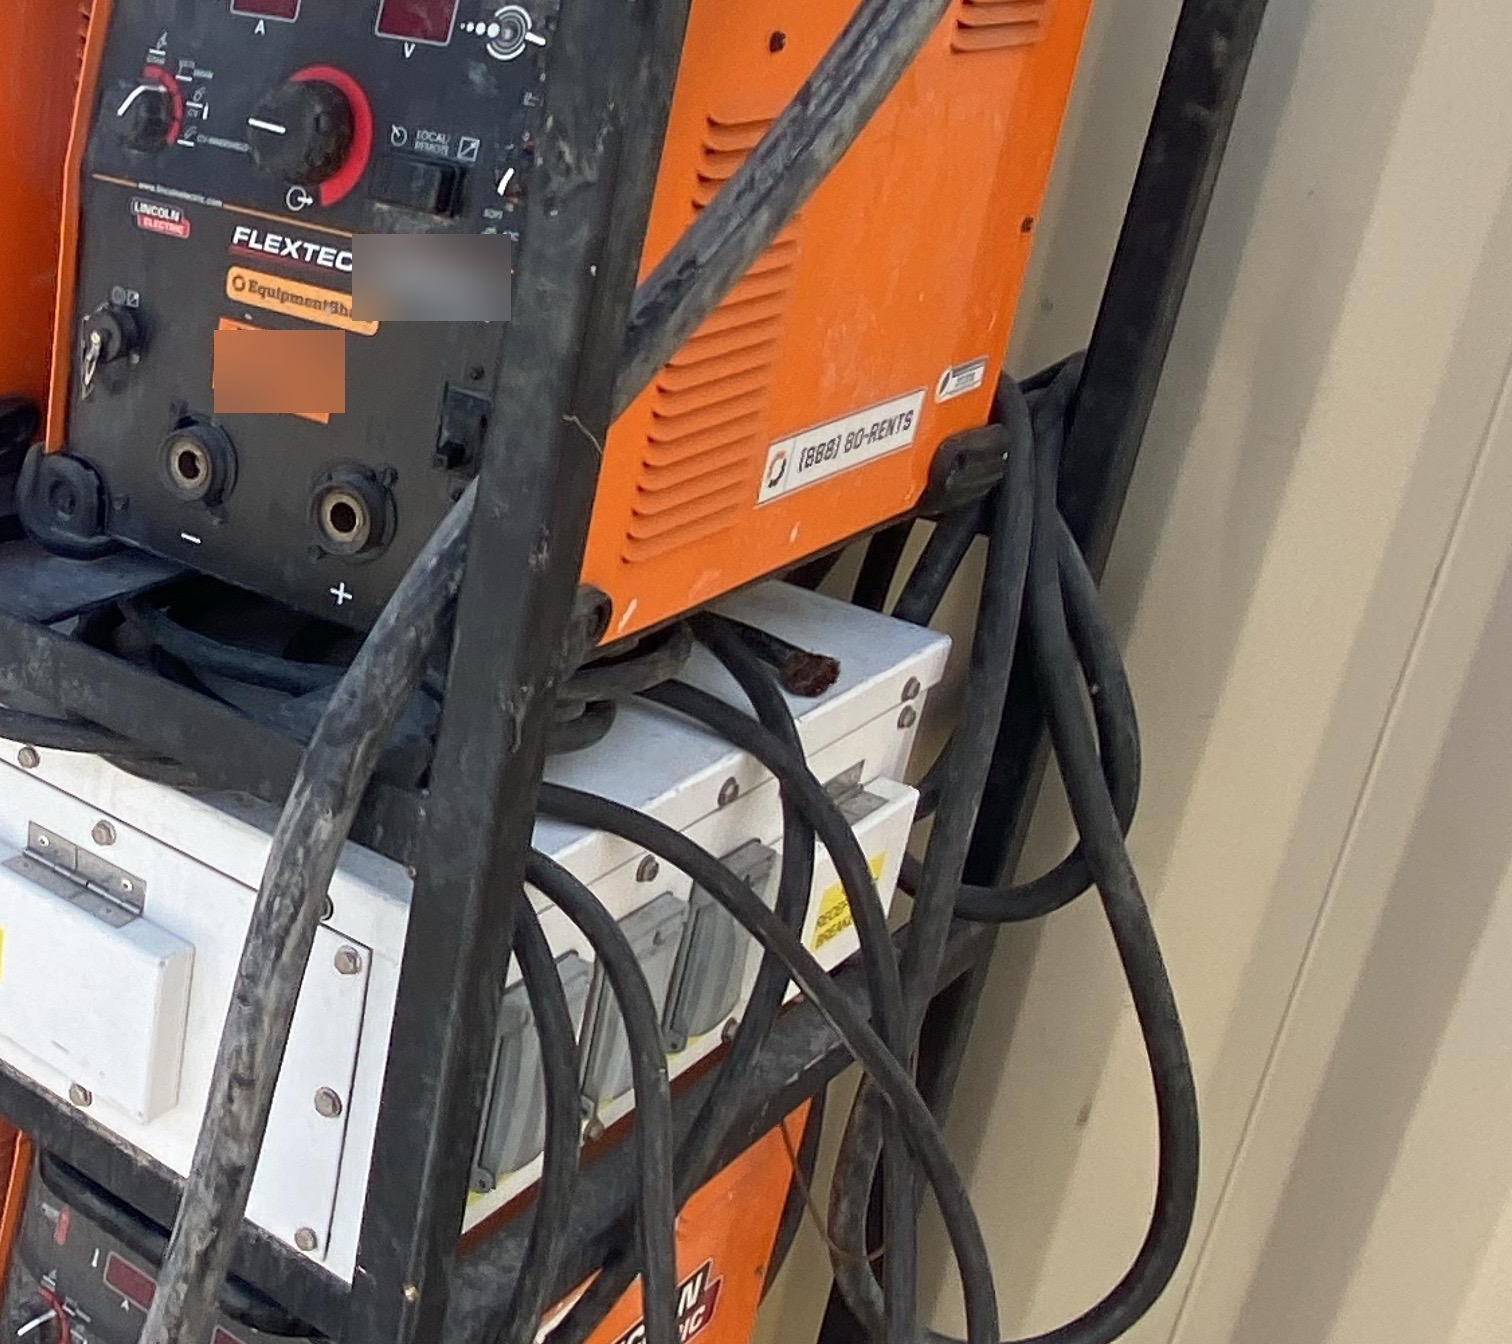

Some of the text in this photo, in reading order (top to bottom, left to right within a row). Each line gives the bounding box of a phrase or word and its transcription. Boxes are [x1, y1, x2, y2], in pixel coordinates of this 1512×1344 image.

[134, 200, 182, 223] LINCOLN
[231, 225, 353, 273] FLEXTEC
[844, 408, 915, 455] 80-RENTS
